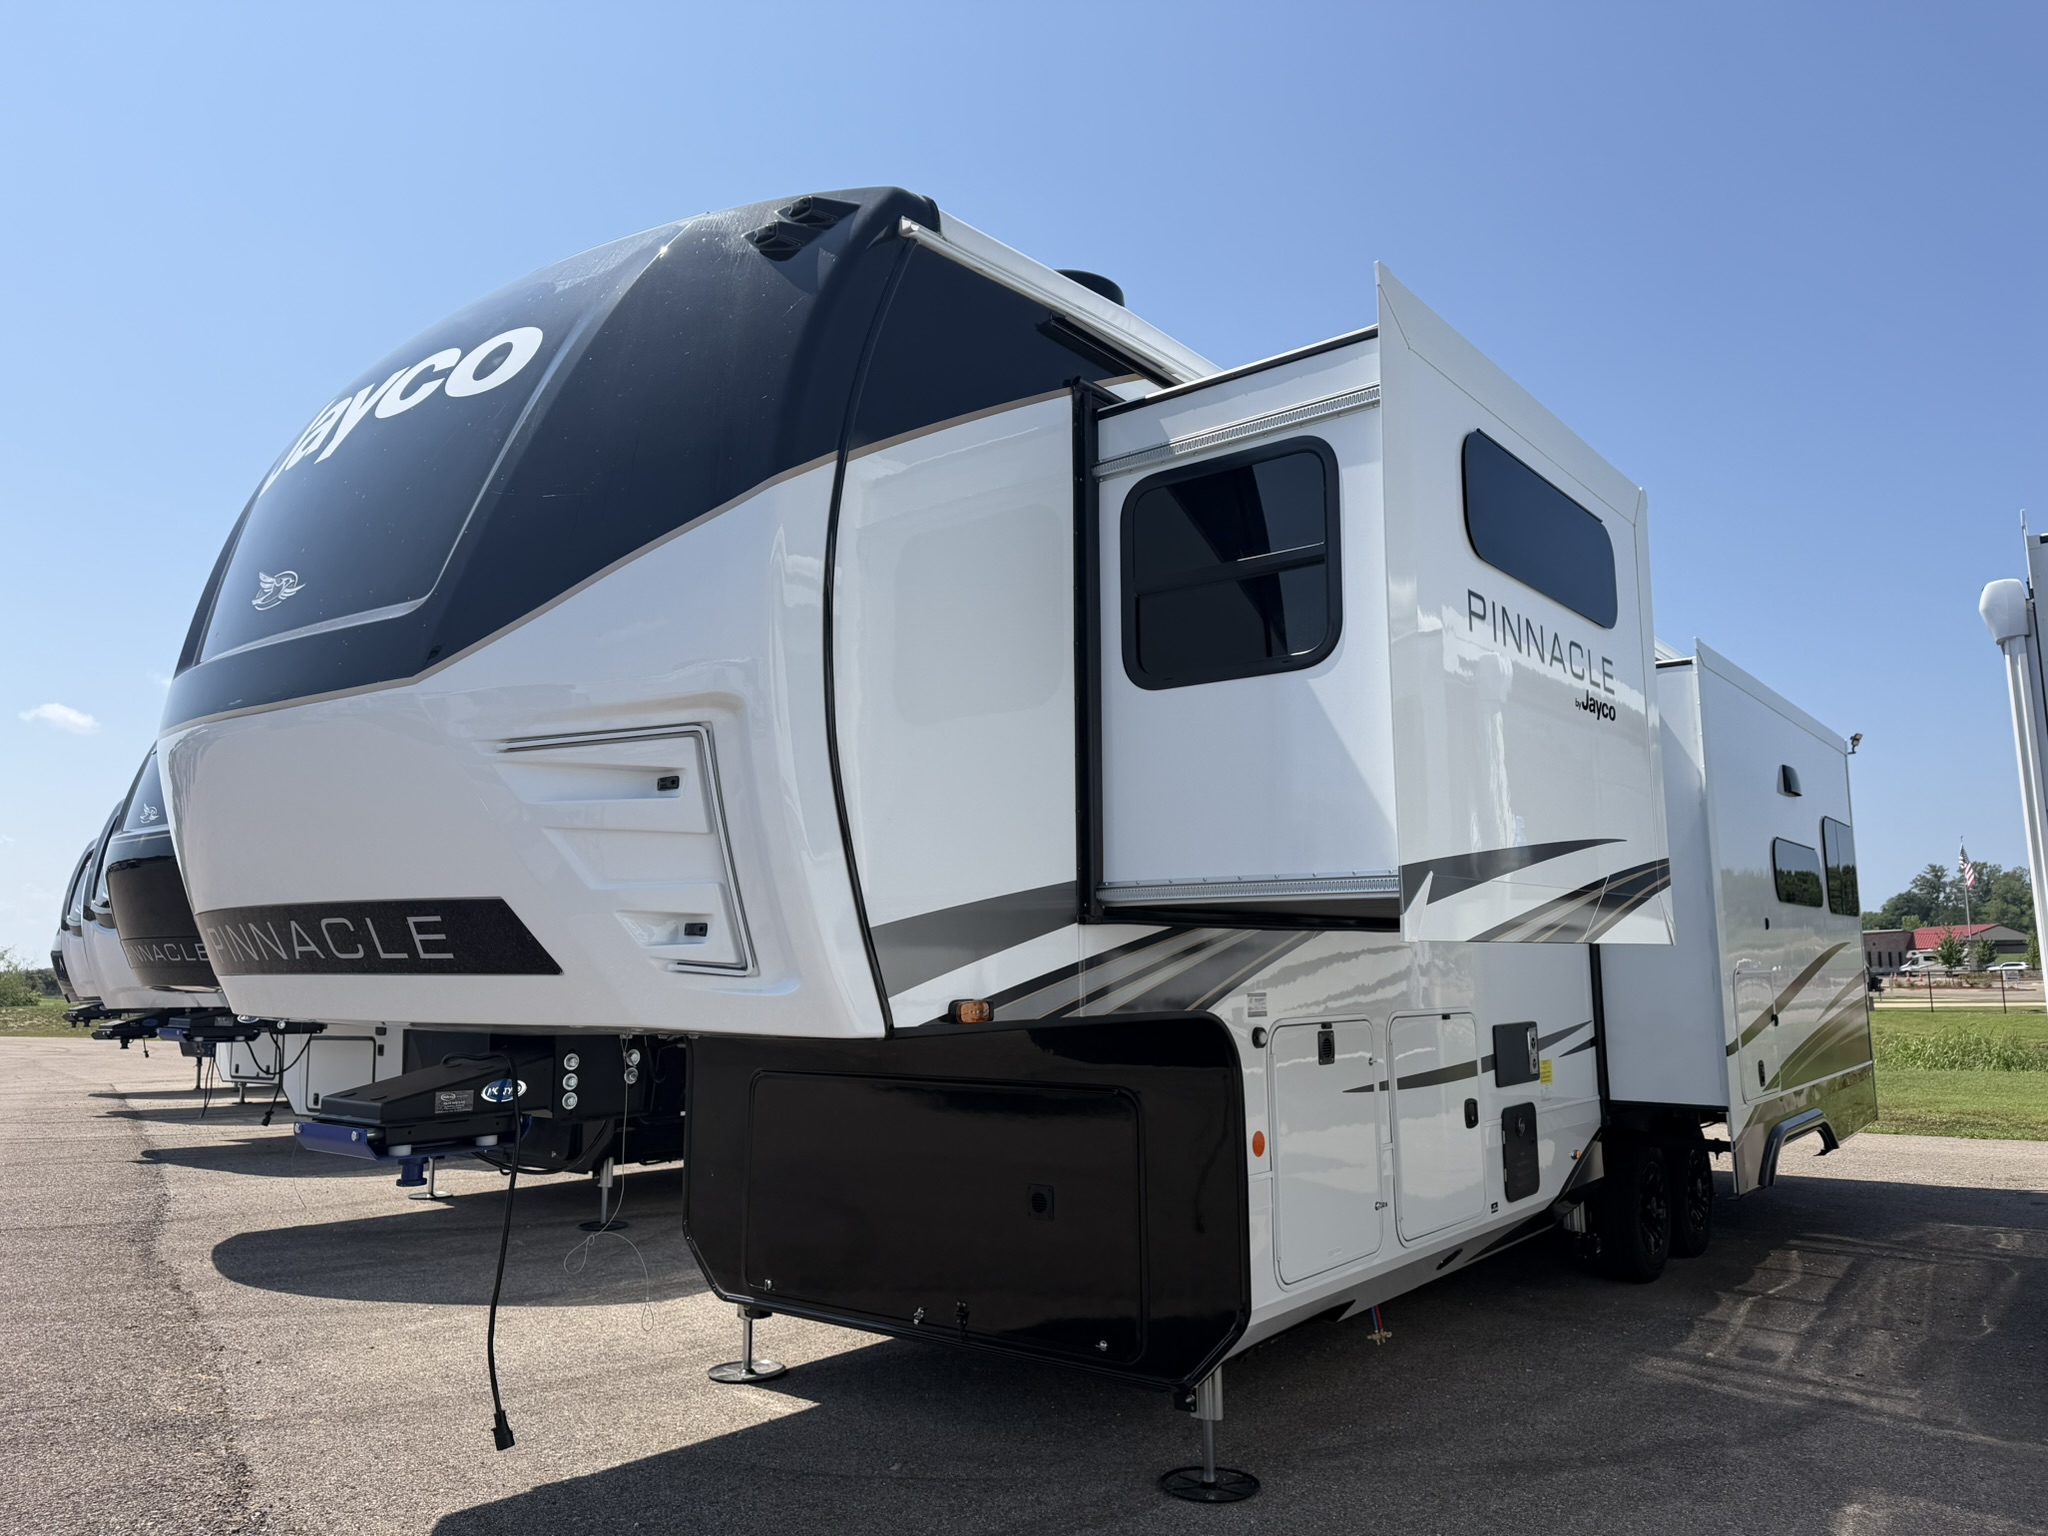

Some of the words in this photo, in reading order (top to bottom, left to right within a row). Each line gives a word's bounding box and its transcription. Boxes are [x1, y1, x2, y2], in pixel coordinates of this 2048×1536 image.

[258, 326, 543, 498] Jayco
[1467, 588, 1615, 695] PINNACLE
[1575, 697, 1582, 711] by
[1581, 690, 1616, 721] Jayco
[207, 914, 454, 964] PINNACLE
